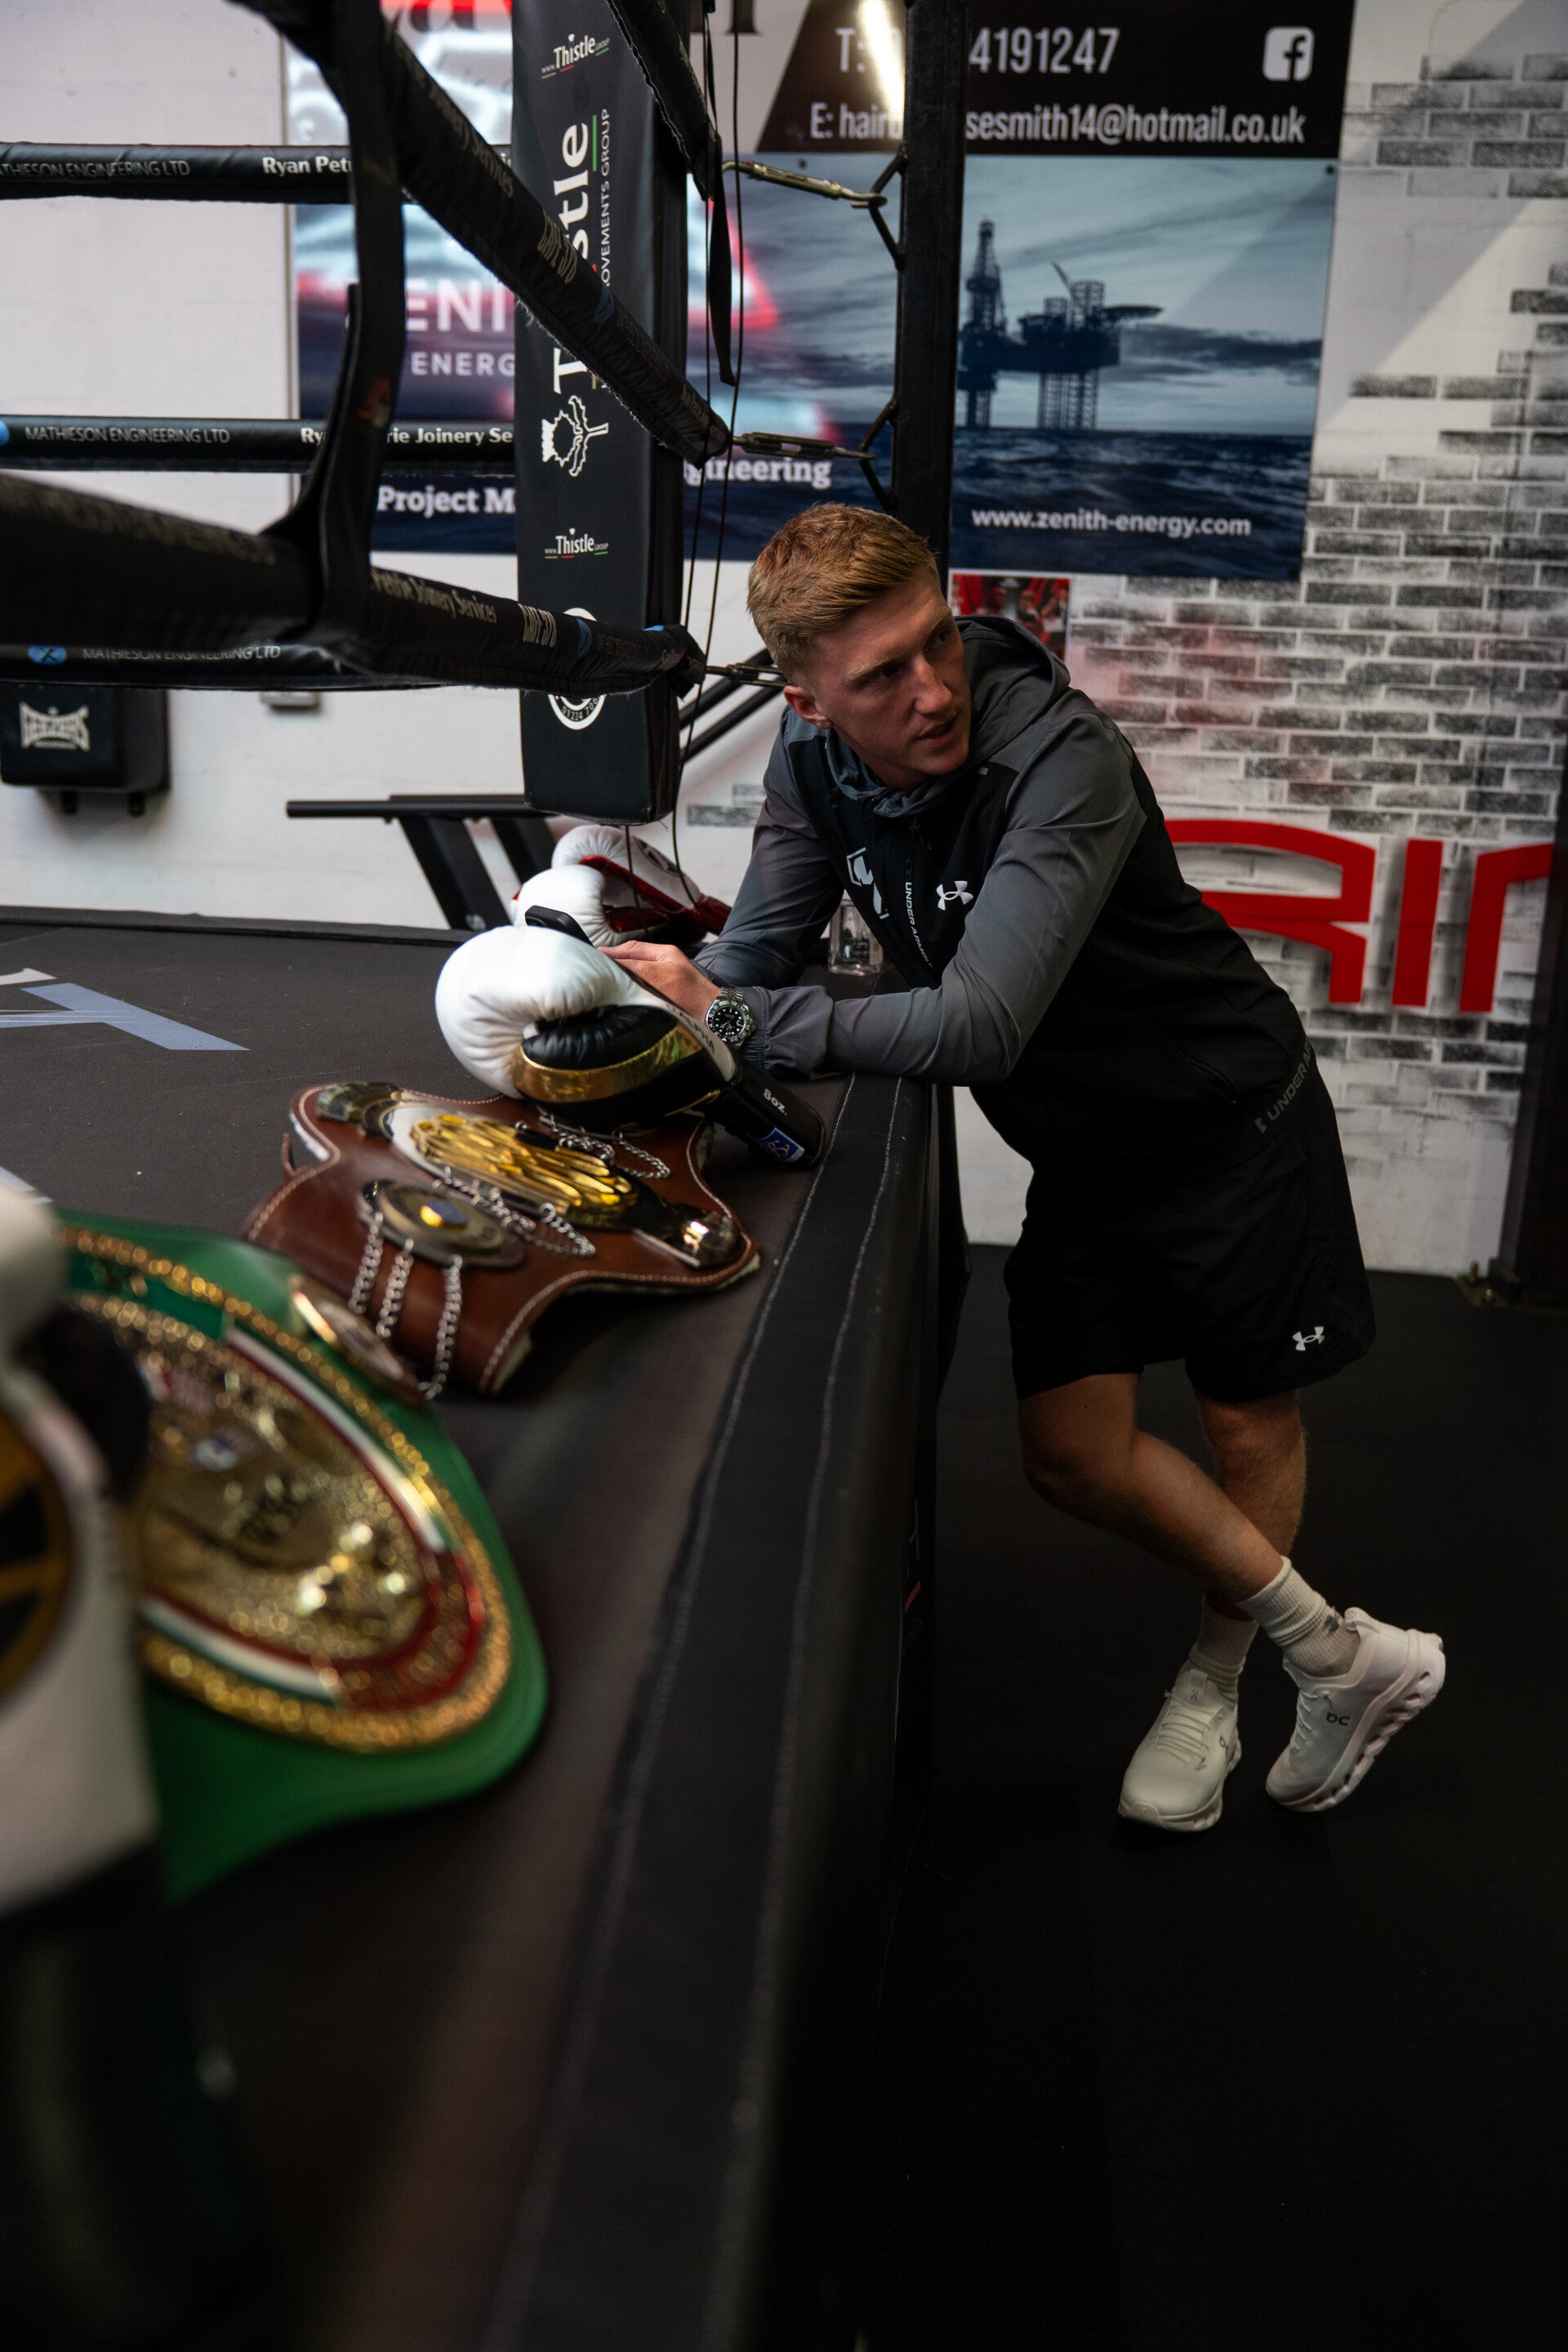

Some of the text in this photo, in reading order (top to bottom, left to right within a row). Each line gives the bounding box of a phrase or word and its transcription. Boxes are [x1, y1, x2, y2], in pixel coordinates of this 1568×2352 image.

[163, 160, 191, 176] LTD
[261, 156, 311, 176] Ryan
[601, 108, 611, 287] OVEMENTS GROUP
[24, 425, 231, 443] MATHIESON ENGINEERING LTD
[414, 427, 485, 448] Joinery
[376, 484, 481, 520] Project
[971, 508, 1252, 539] www.zenith-energy.com
[256, 645, 282, 660] LTD
[905, 881, 915, 926] UNDER
[1266, 1062, 1307, 1121] UNDER
